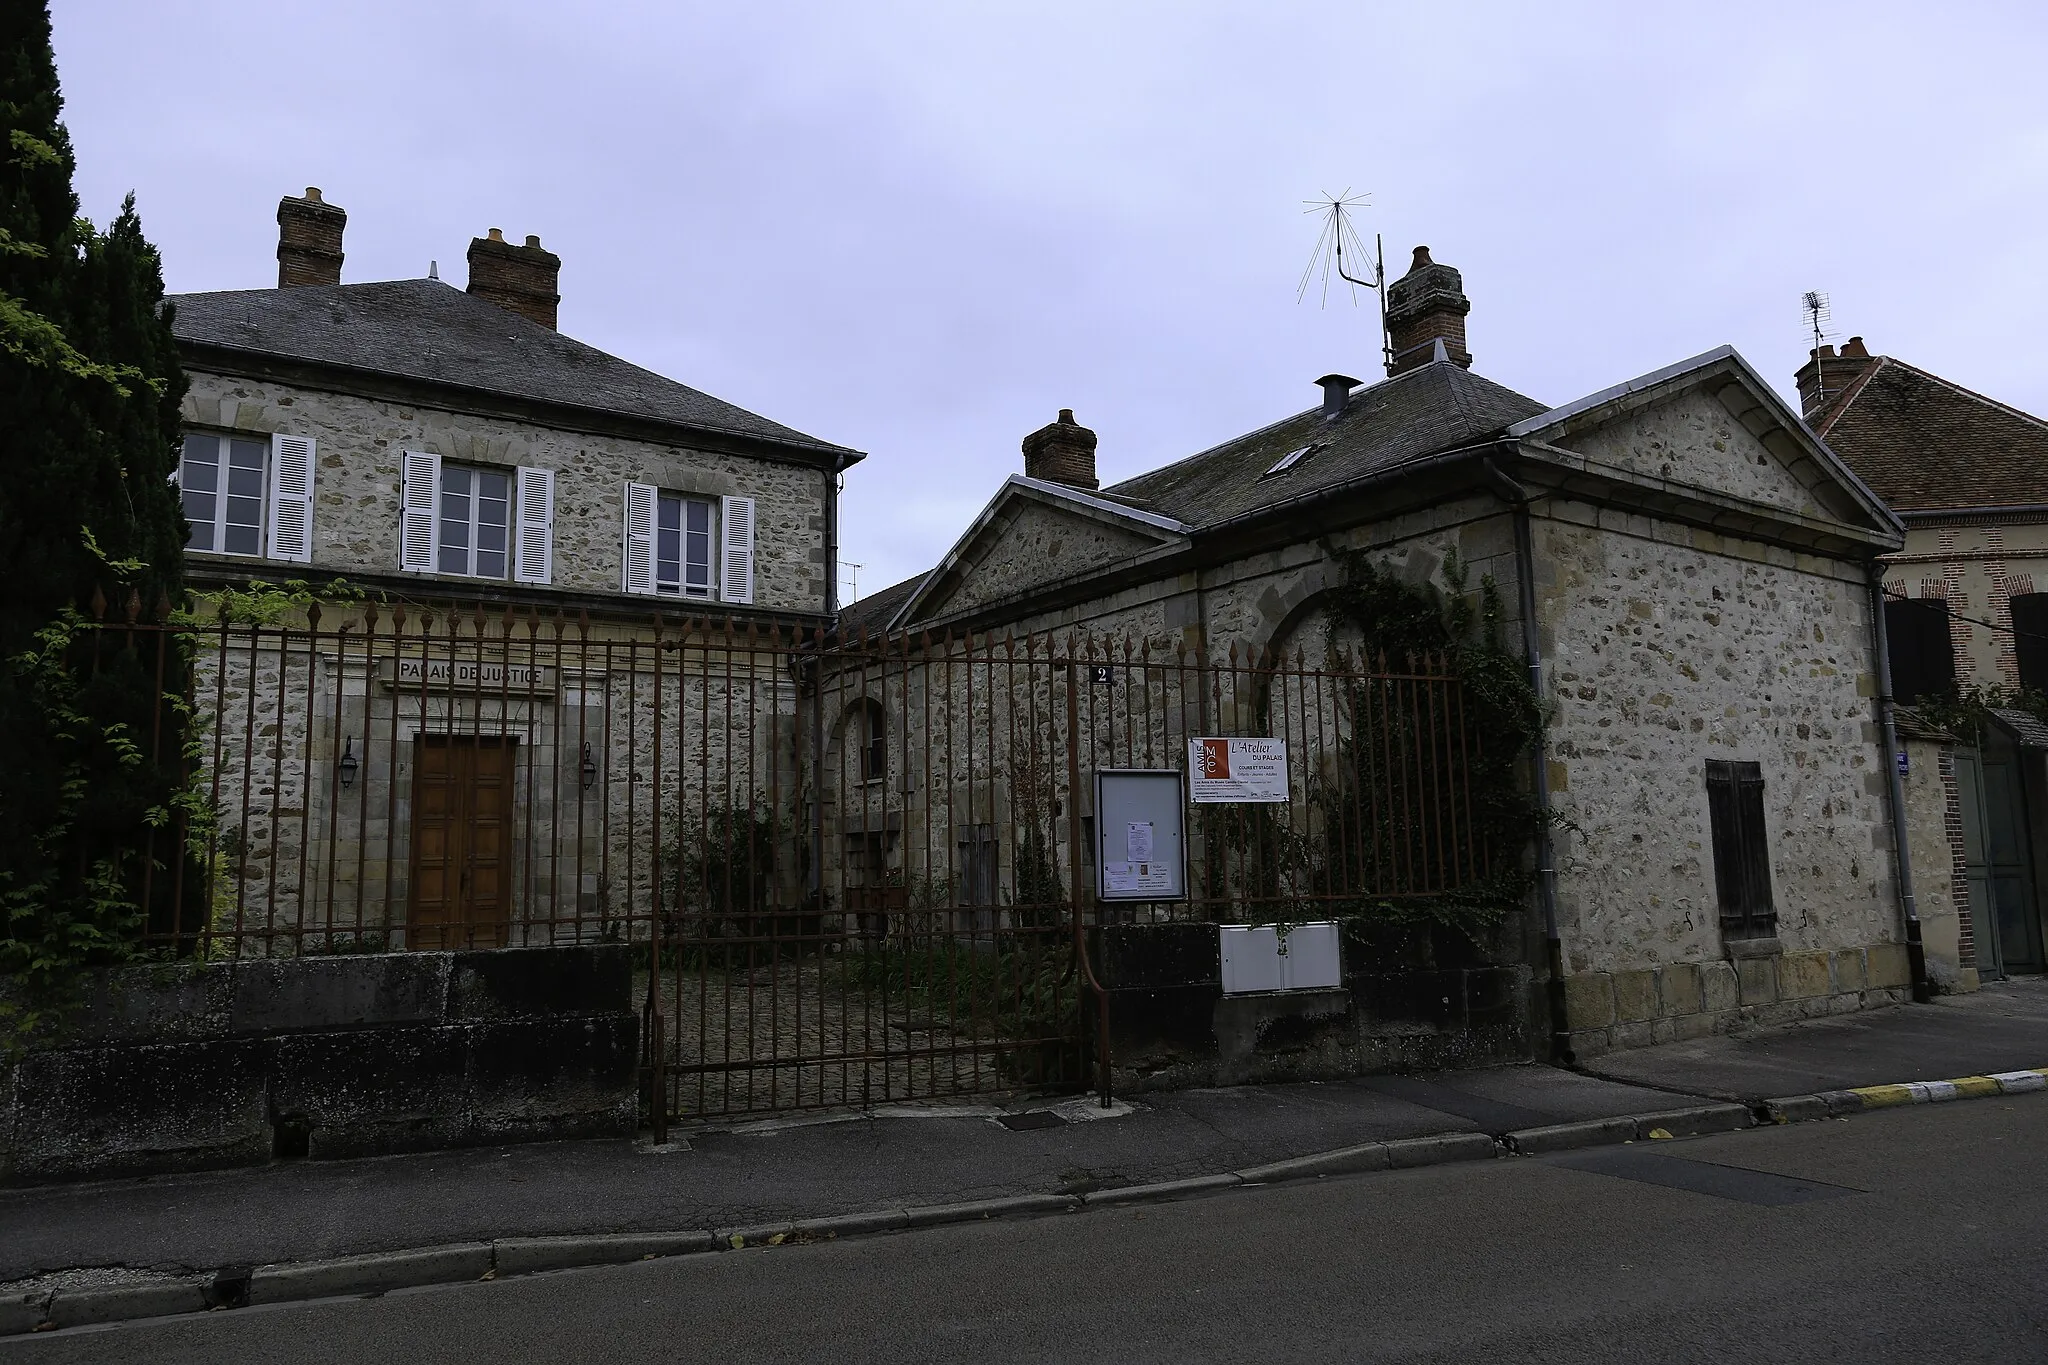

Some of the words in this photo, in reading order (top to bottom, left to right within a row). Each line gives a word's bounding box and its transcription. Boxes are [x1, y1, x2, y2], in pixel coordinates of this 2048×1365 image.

[401, 663, 455, 679] PAAIS
[460, 666, 480, 680] DE
[1098, 667, 1106, 681] 2
[1231, 741, 1272, 754] L'Atelier
[1197, 745, 1206, 773] AMIS
